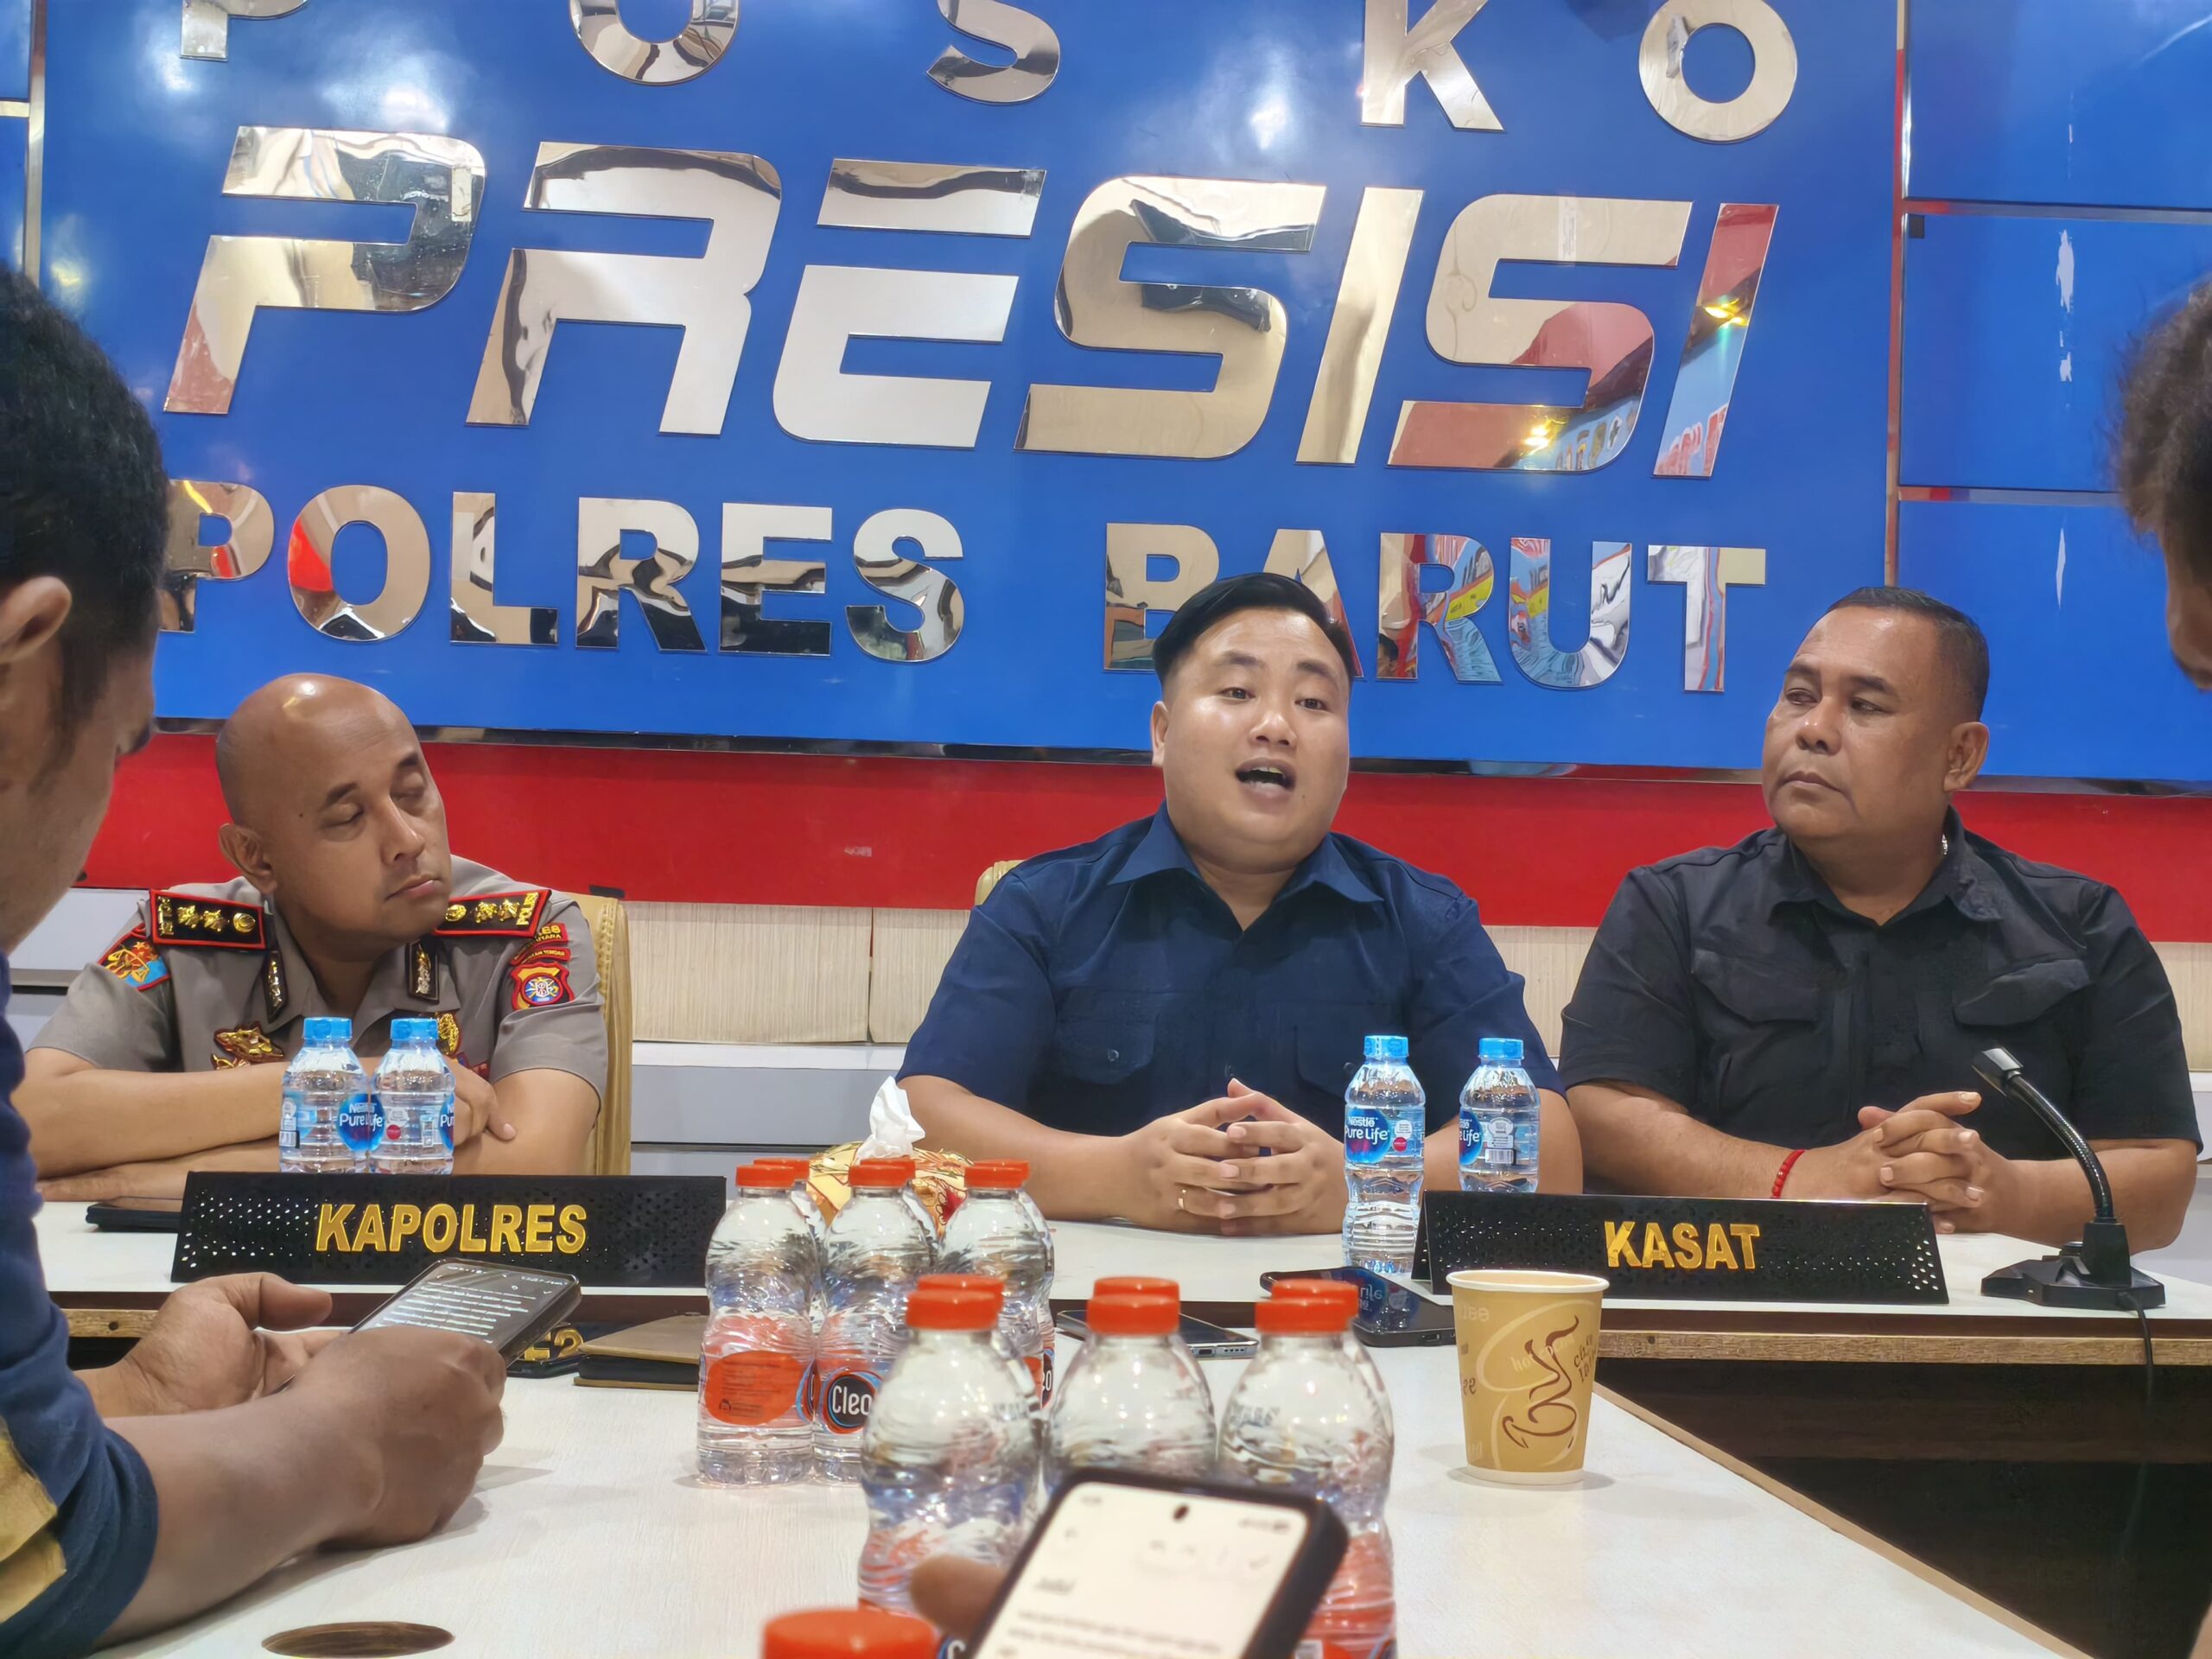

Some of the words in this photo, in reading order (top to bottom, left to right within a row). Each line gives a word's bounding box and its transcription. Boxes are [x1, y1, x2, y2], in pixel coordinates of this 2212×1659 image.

[163, 125, 1780, 478] PRESISI
[158, 479, 965, 664] POLRES
[1364, 1127, 1389, 1145] Life
[1463, 1129, 1480, 1147] Life
[316, 1203, 588, 1254] KAPOLRES
[1604, 1220, 1761, 1269] KASAT
[832, 1385, 873, 1416] Cleo
